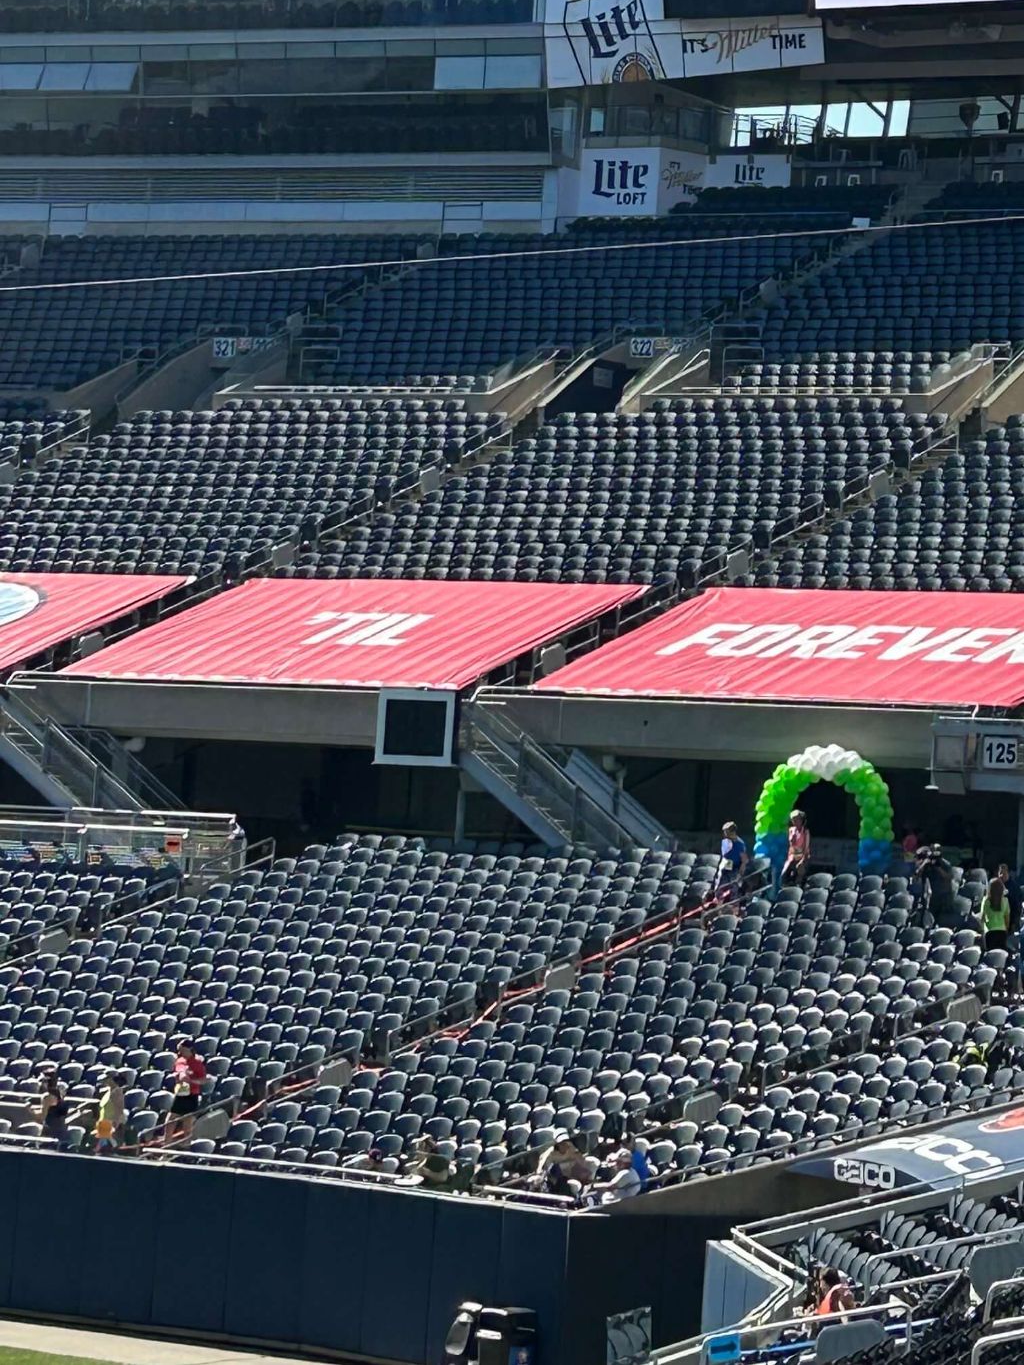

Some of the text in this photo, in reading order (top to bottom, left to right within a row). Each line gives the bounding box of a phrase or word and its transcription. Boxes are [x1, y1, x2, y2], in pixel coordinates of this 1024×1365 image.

[579, 0, 641, 59] Lite
[768, 33, 807, 50] TIME
[592, 159, 649, 198] Lite
[734, 163, 765, 184] Lite
[616, 192, 647, 206] LOFT
[215, 340, 235, 356] 321
[986, 742, 1016, 764] 125
[833, 1158, 896, 1189] GEICO
